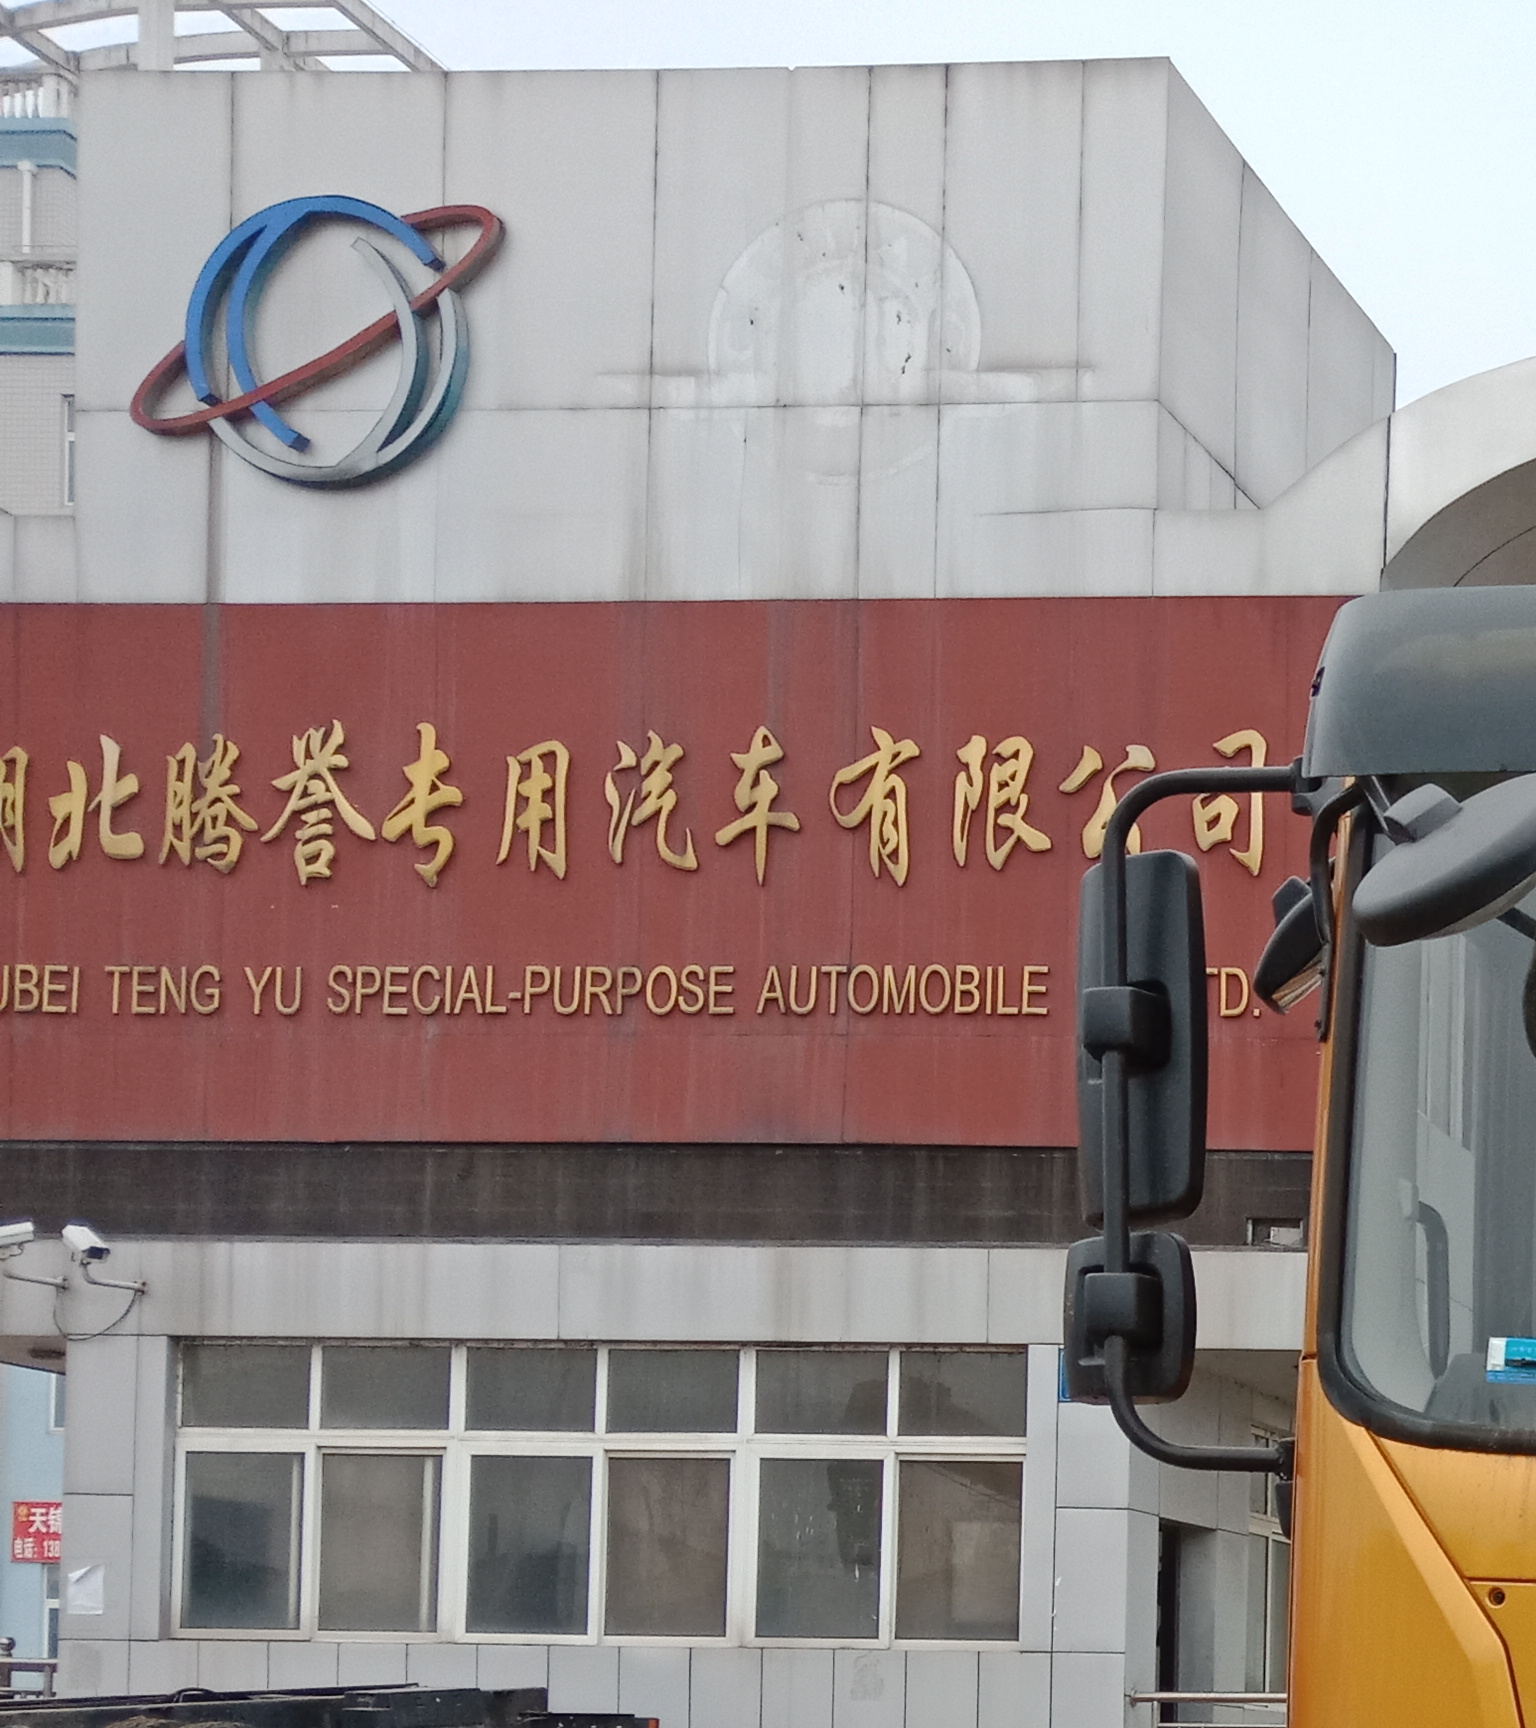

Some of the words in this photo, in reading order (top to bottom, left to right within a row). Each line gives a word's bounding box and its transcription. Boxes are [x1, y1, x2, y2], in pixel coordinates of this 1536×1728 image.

[104, 964, 222, 1015] TENG
[243, 966, 303, 1015] YU
[326, 964, 736, 1016] SPECIAL-PURPOSE
[756, 963, 1050, 1015] AUTOMOBILE
